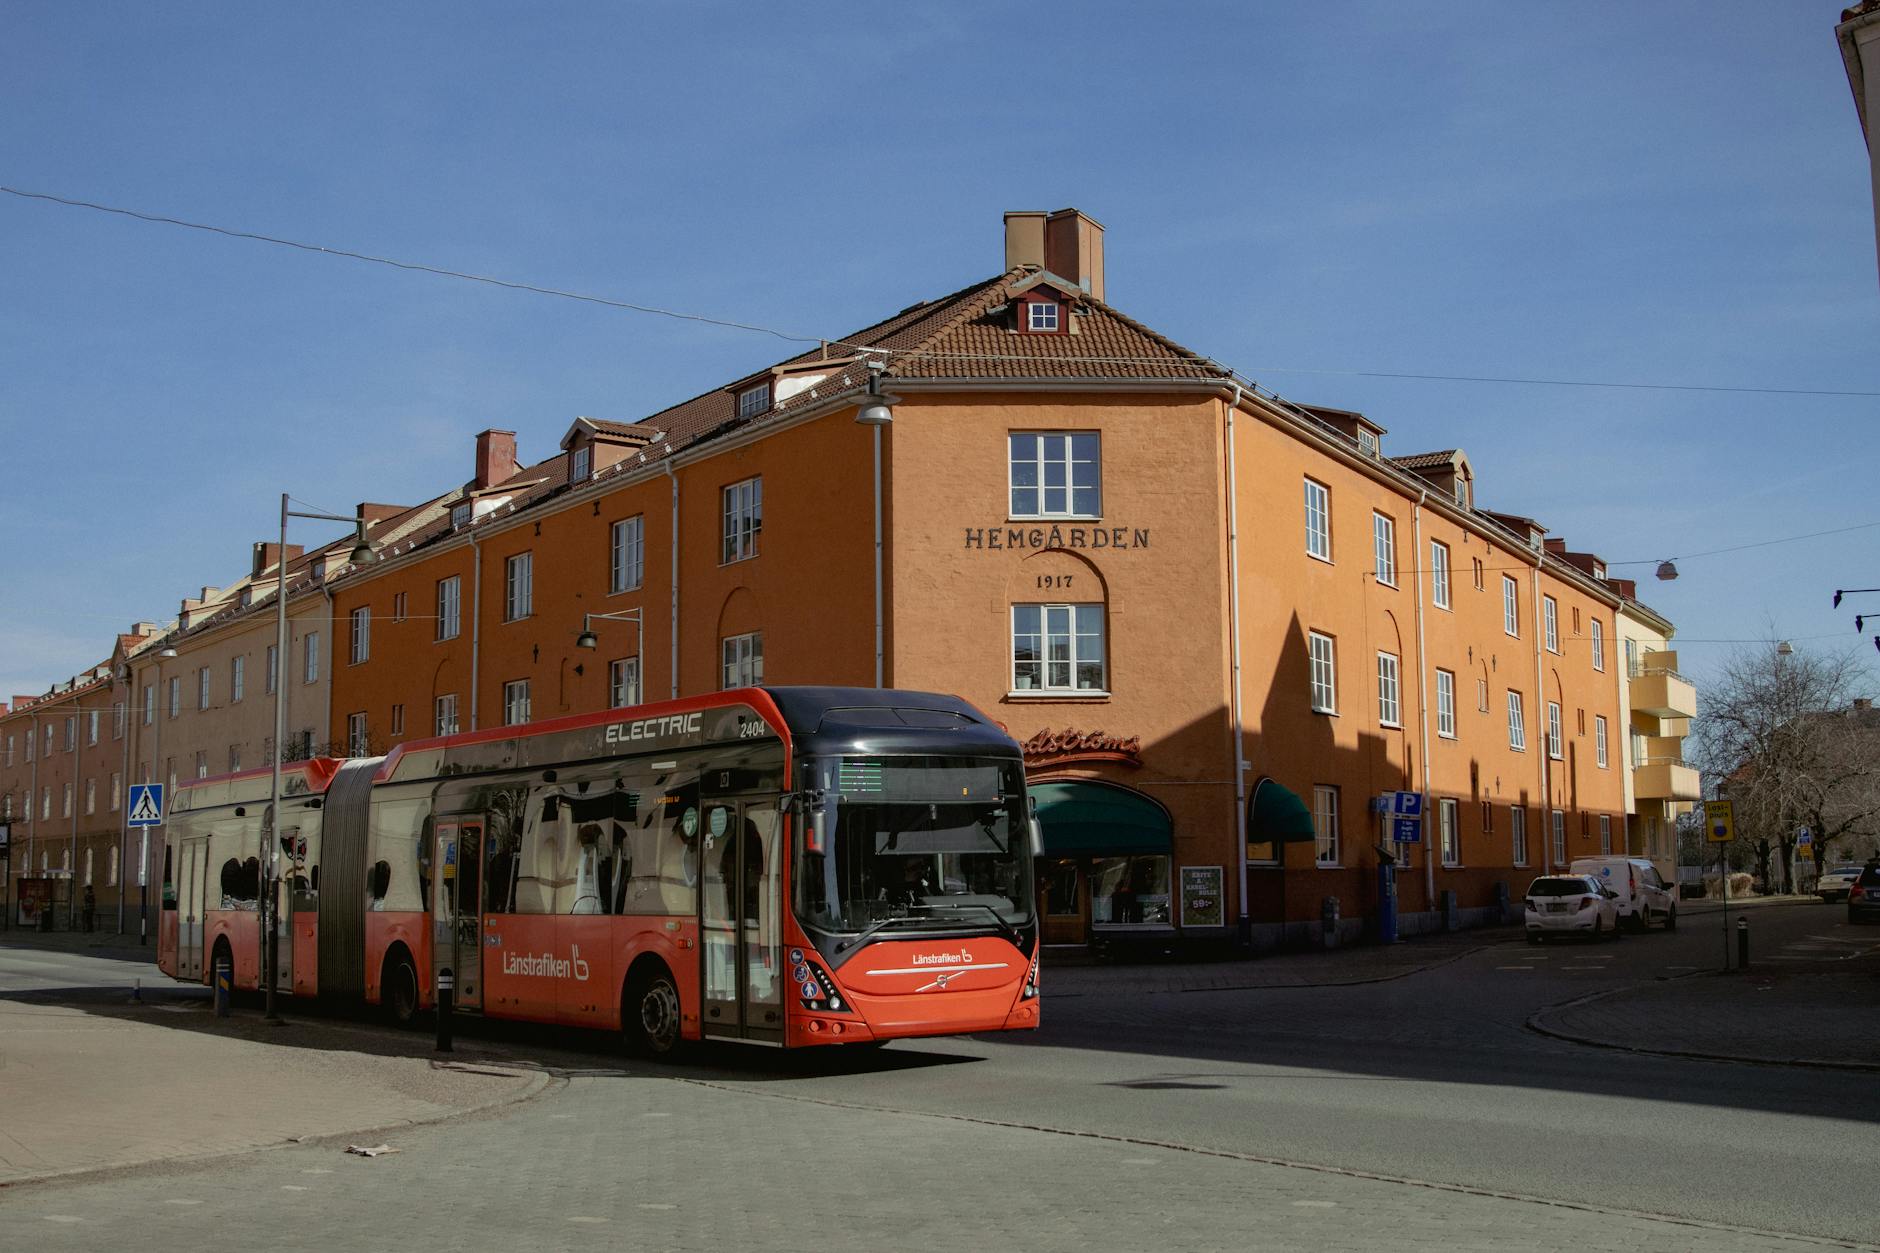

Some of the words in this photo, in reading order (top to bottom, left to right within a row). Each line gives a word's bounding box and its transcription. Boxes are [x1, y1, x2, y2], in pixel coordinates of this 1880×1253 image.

[964, 525, 1150, 550] HEMGÅRDEN
[1036, 575, 1074, 589] 1917
[605, 712, 703, 743] ELECTRIC
[740, 721, 765, 738] 2404
[1380, 799, 1387, 808] P
[1402, 794, 1416, 812] P
[503, 951, 571, 978] Länstrafiken
[913, 953, 961, 965] Länstrafiken
